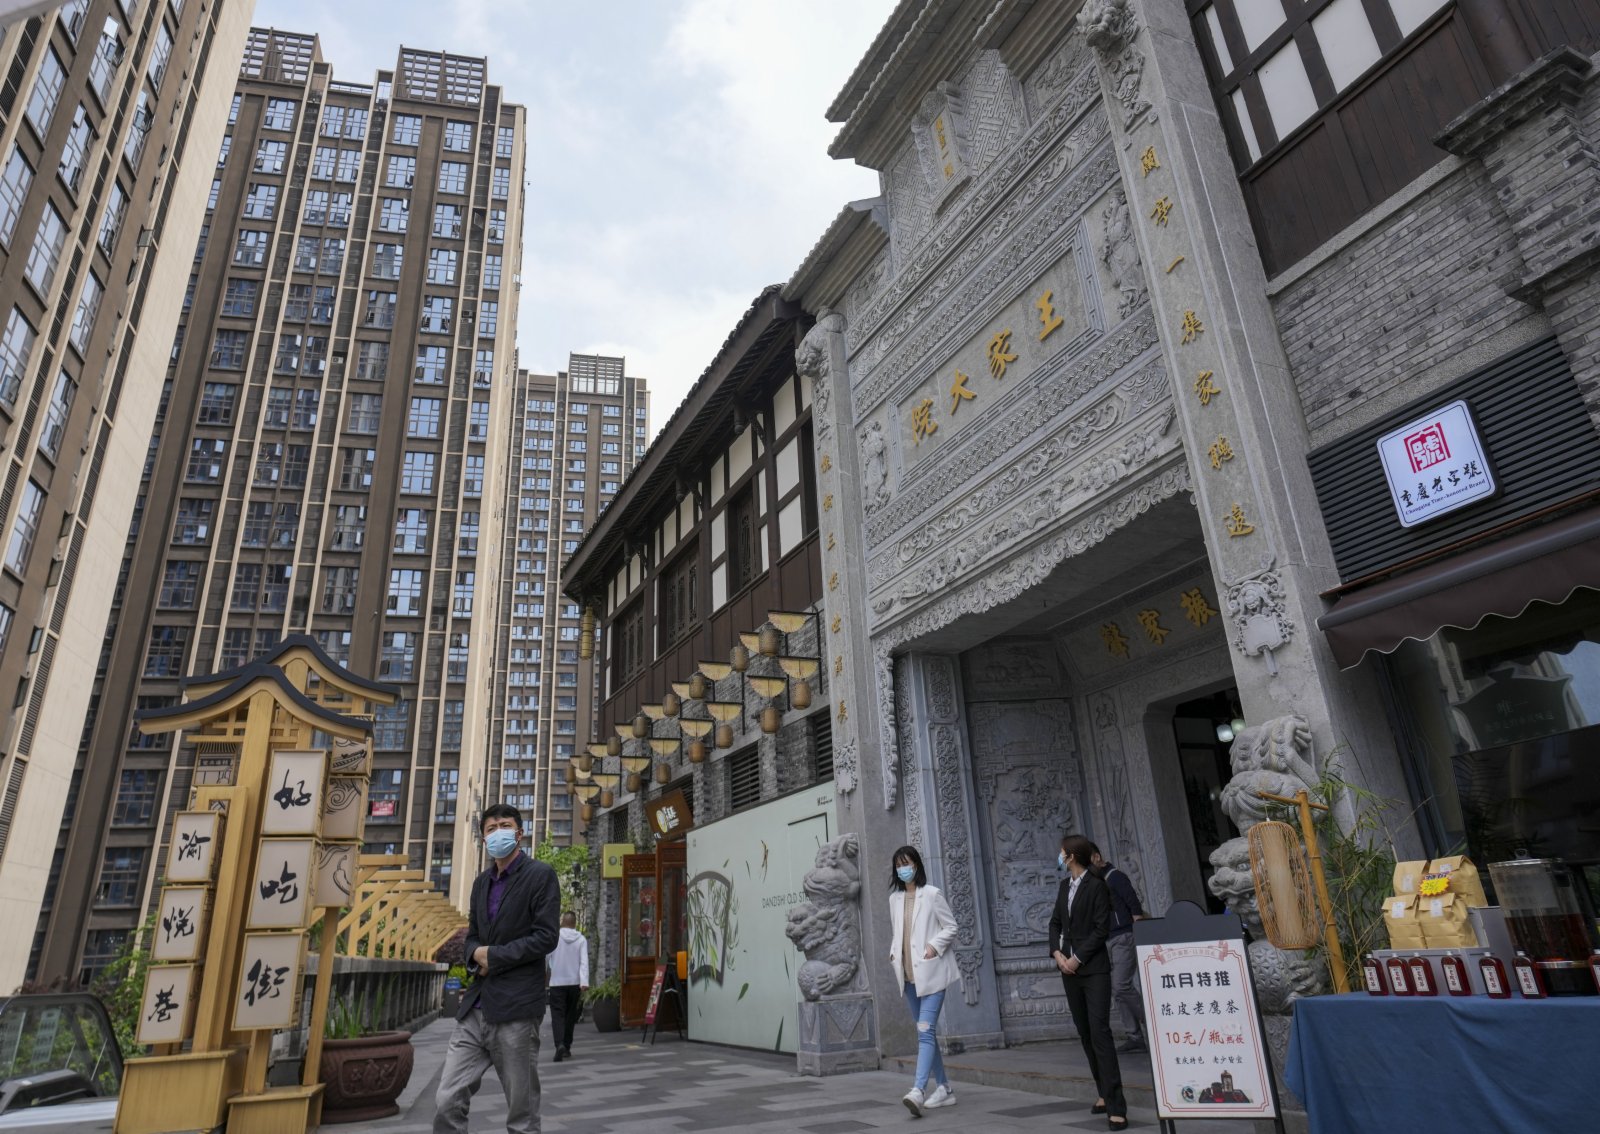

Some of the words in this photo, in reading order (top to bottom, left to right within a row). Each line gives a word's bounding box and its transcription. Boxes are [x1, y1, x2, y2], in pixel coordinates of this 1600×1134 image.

[1161, 970, 1231, 988] 本月特推
[1161, 999, 1240, 1016] 陈皮老鹰茶
